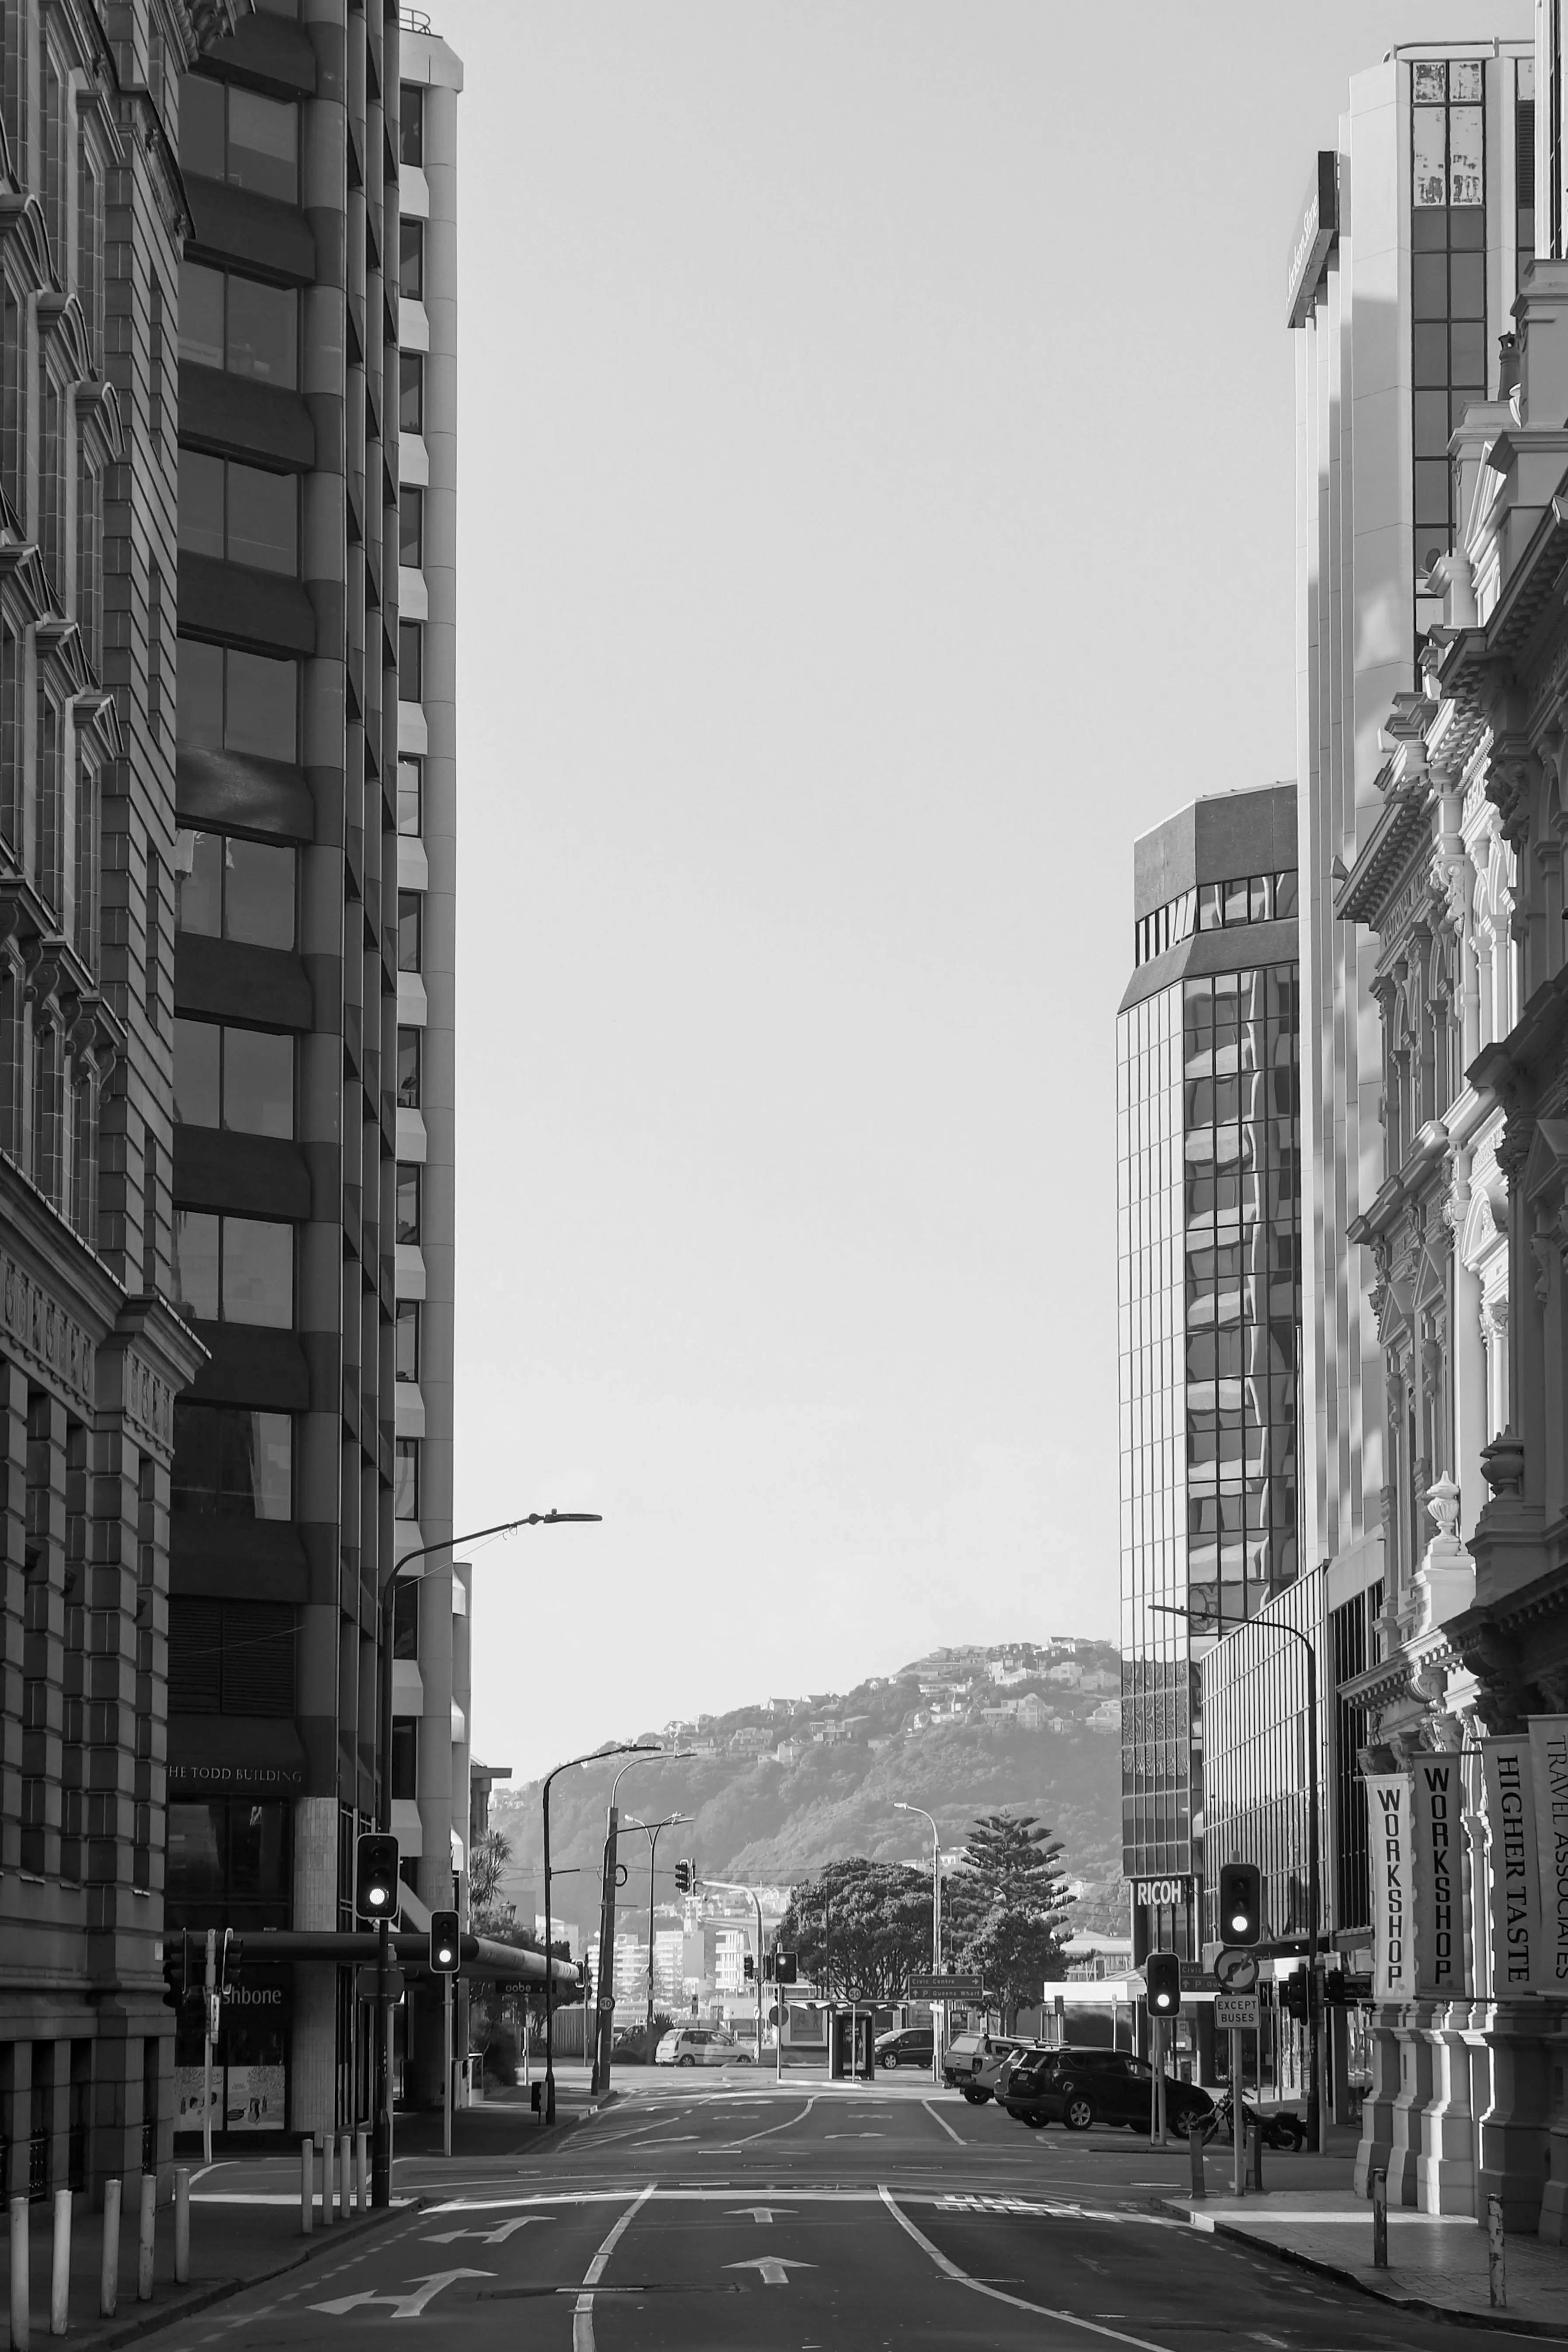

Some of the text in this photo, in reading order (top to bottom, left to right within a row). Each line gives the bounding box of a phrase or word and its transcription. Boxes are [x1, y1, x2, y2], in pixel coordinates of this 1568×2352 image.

[191, 1767, 231, 1780] TODD
[236, 1769, 302, 1783] BUILDING
[1547, 1735, 1568, 1825] TRAVEL
[1424, 1768, 1451, 1984] WORKSHOP
[1497, 1755, 1530, 1982] HIGHER TASTE
[1138, 1880, 1181, 1905] RICOH
[1377, 1789, 1402, 1988] WORKSHOP
[601, 1999, 611, 2008] 50
[1218, 2001, 1256, 2010] EXCEPT
[1221, 2013, 1254, 2022] BUSES
